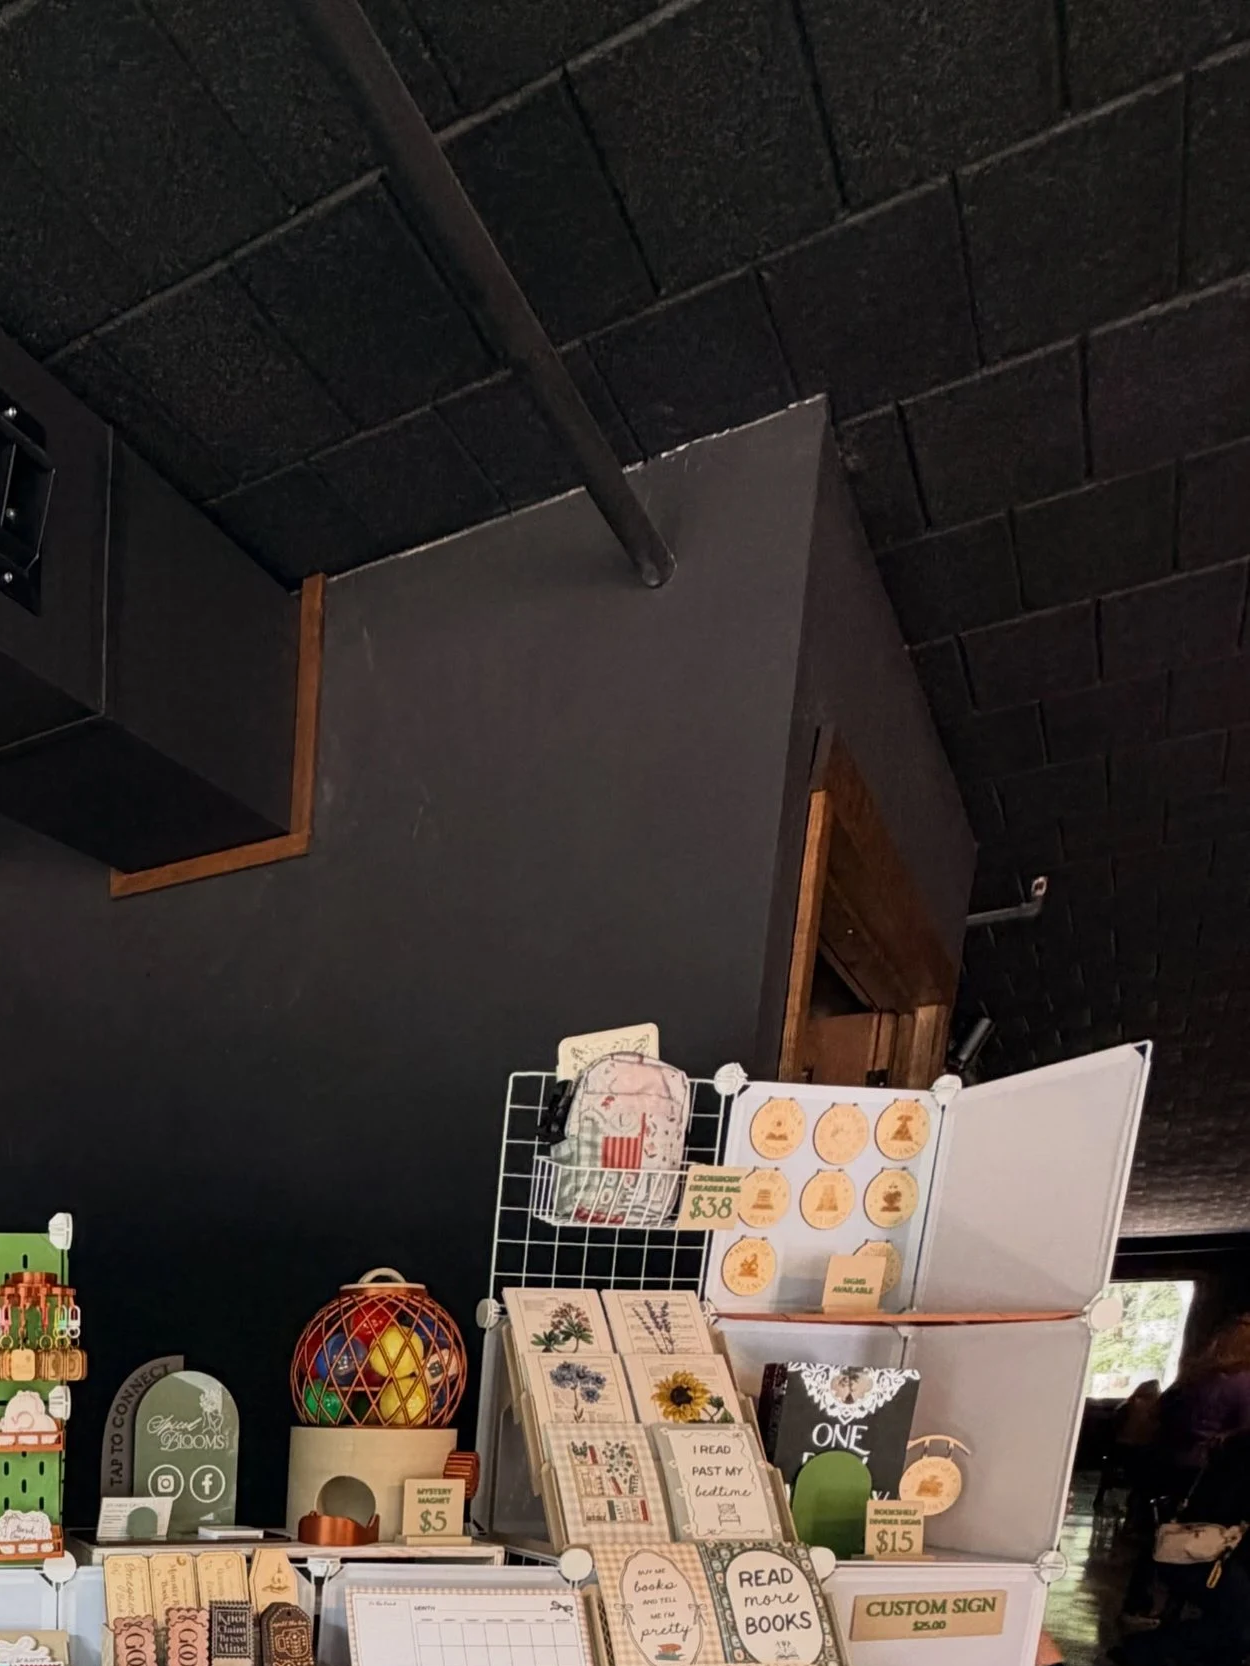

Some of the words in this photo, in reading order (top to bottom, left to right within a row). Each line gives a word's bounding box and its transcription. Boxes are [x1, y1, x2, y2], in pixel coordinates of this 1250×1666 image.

[689, 1194, 733, 1220] $38
[832, 1286, 874, 1295] AVAILABLE
[112, 1363, 170, 1428] CONNECT
[111, 1433, 124, 1455] TO
[160, 1430, 225, 1451] BLOOMS
[812, 1422, 871, 1456] ONE
[700, 1444, 731, 1455] READ
[110, 1460, 123, 1487] TAP
[692, 1467, 721, 1477] PAST
[725, 1466, 744, 1477] MY
[416, 1487, 453, 1496] MYSTERY
[694, 1484, 751, 1497] bedtime
[417, 1496, 450, 1505] MAGNET
[874, 1508, 918, 1516] BOOKSHELF
[419, 1510, 447, 1534] $5
[876, 1530, 914, 1554] $15
[738, 1567, 793, 1588] READ
[634, 1579, 678, 1592] books
[744, 1592, 799, 1607] more
[865, 1600, 947, 1617] CUSTOM
[952, 1596, 997, 1614] SIGN
[217, 1613, 247, 1625] Knot
[746, 1611, 812, 1635] BOOKS
[912, 1620, 946, 1631] $25.00
[217, 1625, 246, 1634] Claim
[640, 1622, 692, 1643] pretty
[218, 1634, 247, 1643] Breed
[218, 1643, 247, 1654] Mine
